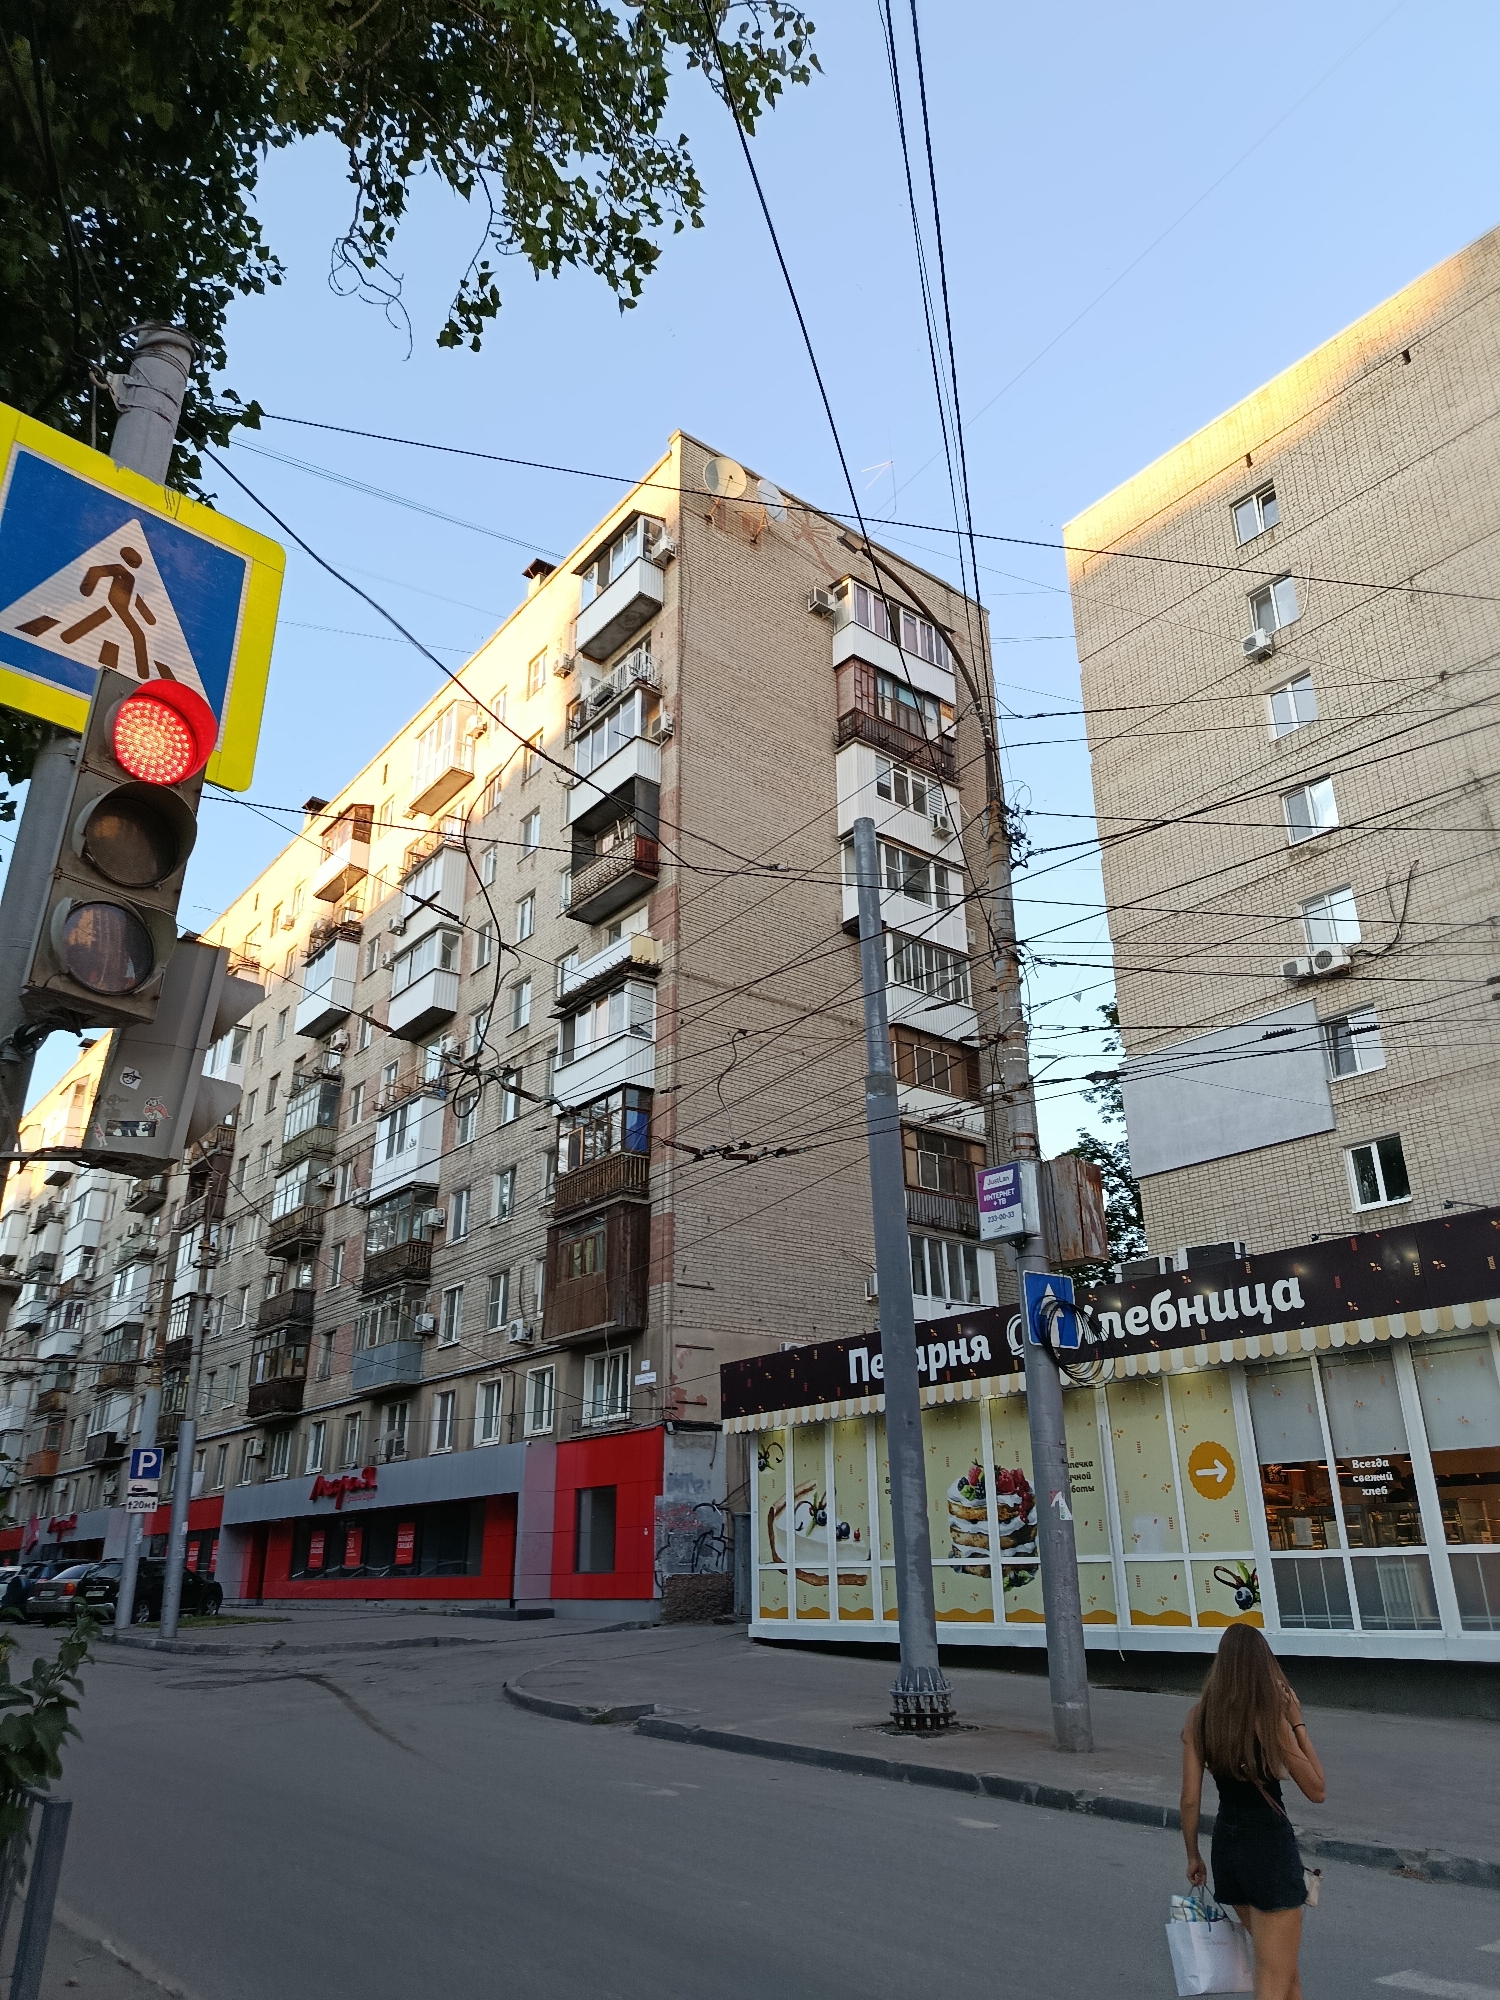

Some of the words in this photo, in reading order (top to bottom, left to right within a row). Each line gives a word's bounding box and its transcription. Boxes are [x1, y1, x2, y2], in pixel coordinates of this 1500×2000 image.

[983, 1188, 1015, 1202] ИНТЕРНЕТ
[998, 1198, 1007, 1206] ТВ
[987, 1211, 1015, 1223] 233-00-33
[848, 1334, 992, 1384] Пеарня
[137, 1452, 158, 1477] P
[1068, 1460, 1094, 1468] печка
[1352, 1457, 1390, 1469] Всегда
[1069, 1472, 1092, 1483] учной
[1071, 1485, 1095, 1493] боты
[1362, 1486, 1388, 1496] хлеб
